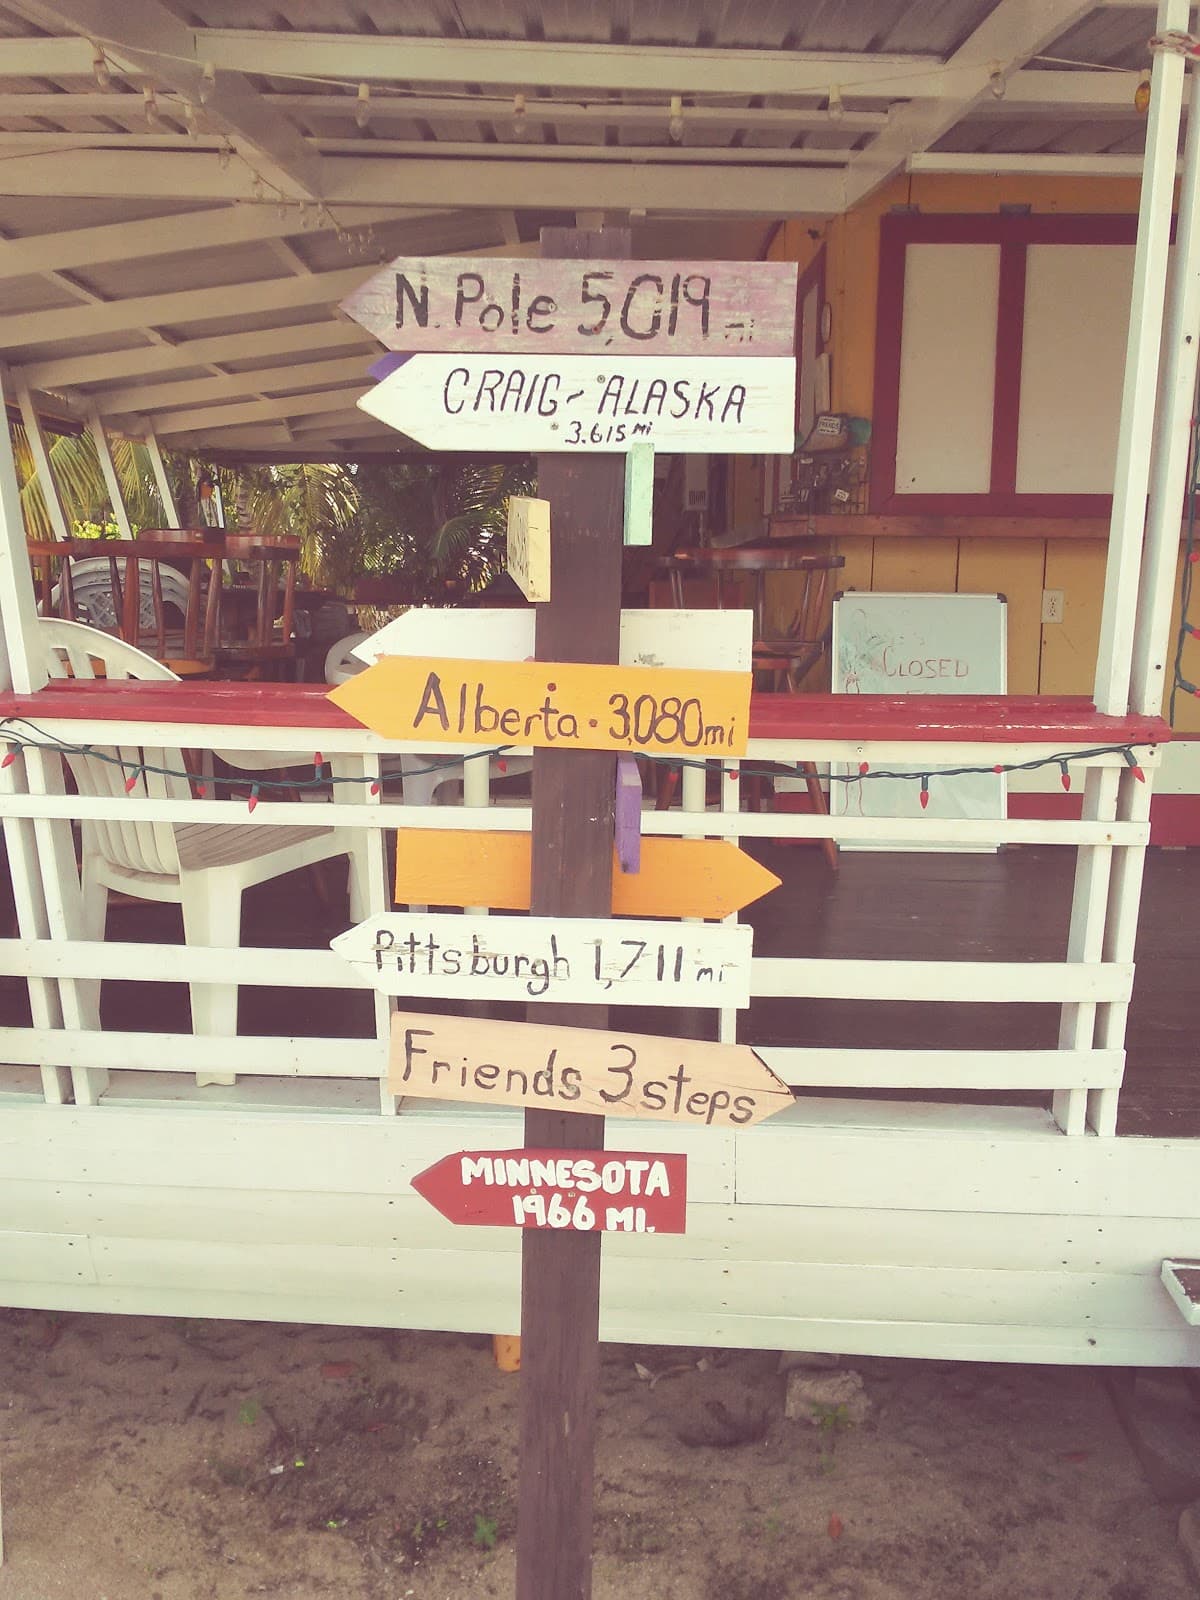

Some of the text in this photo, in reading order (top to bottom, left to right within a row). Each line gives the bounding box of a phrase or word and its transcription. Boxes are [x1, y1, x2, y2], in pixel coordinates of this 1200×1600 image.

[395, 272, 440, 329] N.
[454, 272, 558, 335] Pole
[577, 271, 711, 346] 5,019
[596, 374, 747, 424] ALASKA
[883, 645, 969, 679] CLOSED
[412, 671, 580, 741] Alberta
[375, 929, 724, 996] Pittsburgh 1,711 mi
[402, 1028, 582, 1101] Friends
[642, 1063, 757, 1126] steps
[460, 1156, 671, 1198] MINNESOTA
[511, 1193, 656, 1234] 1966 MI.
